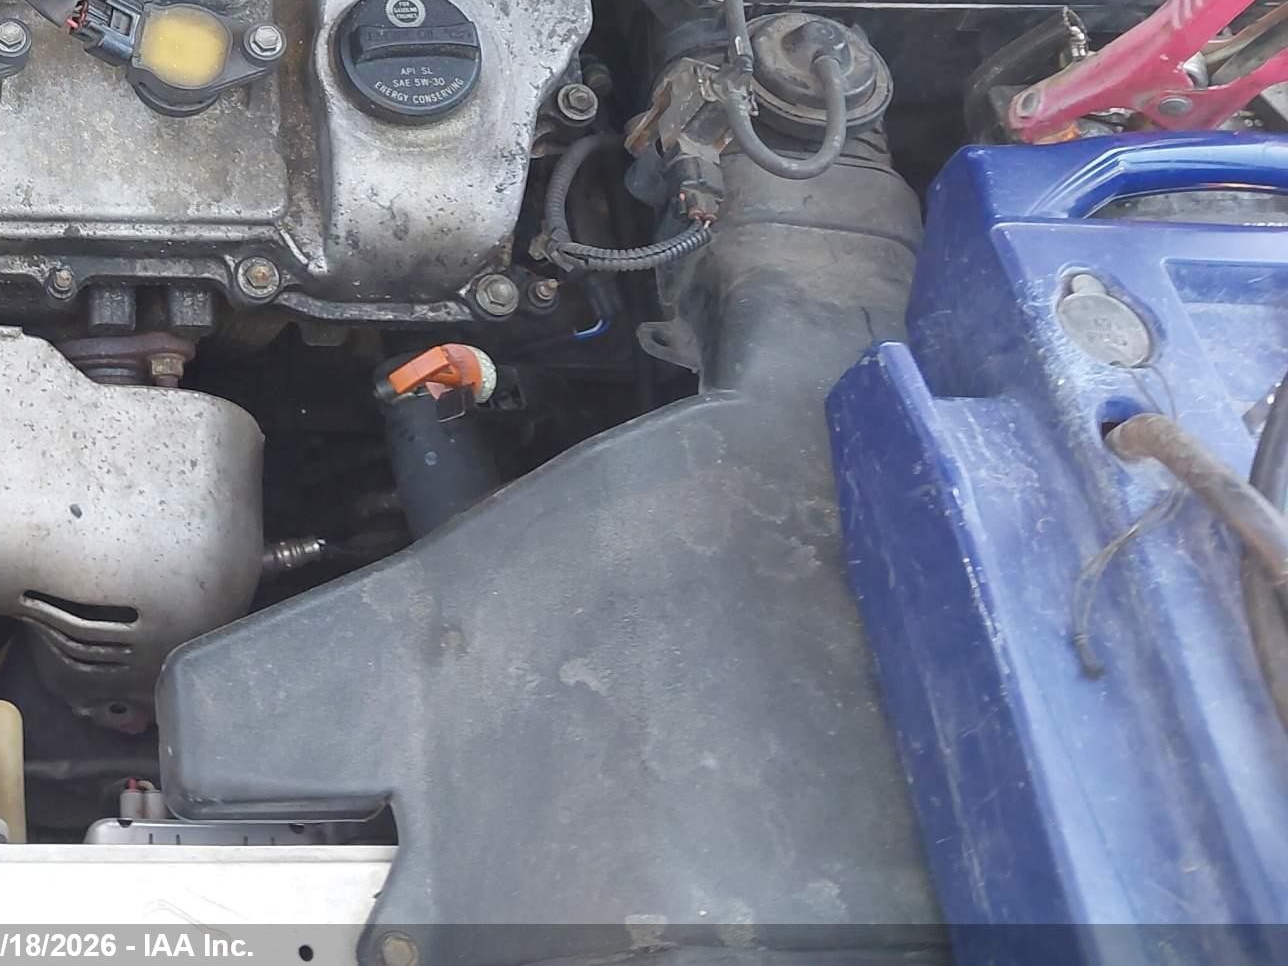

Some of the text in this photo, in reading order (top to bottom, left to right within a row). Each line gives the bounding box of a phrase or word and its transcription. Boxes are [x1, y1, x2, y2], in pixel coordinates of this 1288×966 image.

[400, 66, 433, 75] API SL
[392, 78, 445, 87] SAE 5W-30
[374, 77, 464, 105] ENERGY CONSERVING
